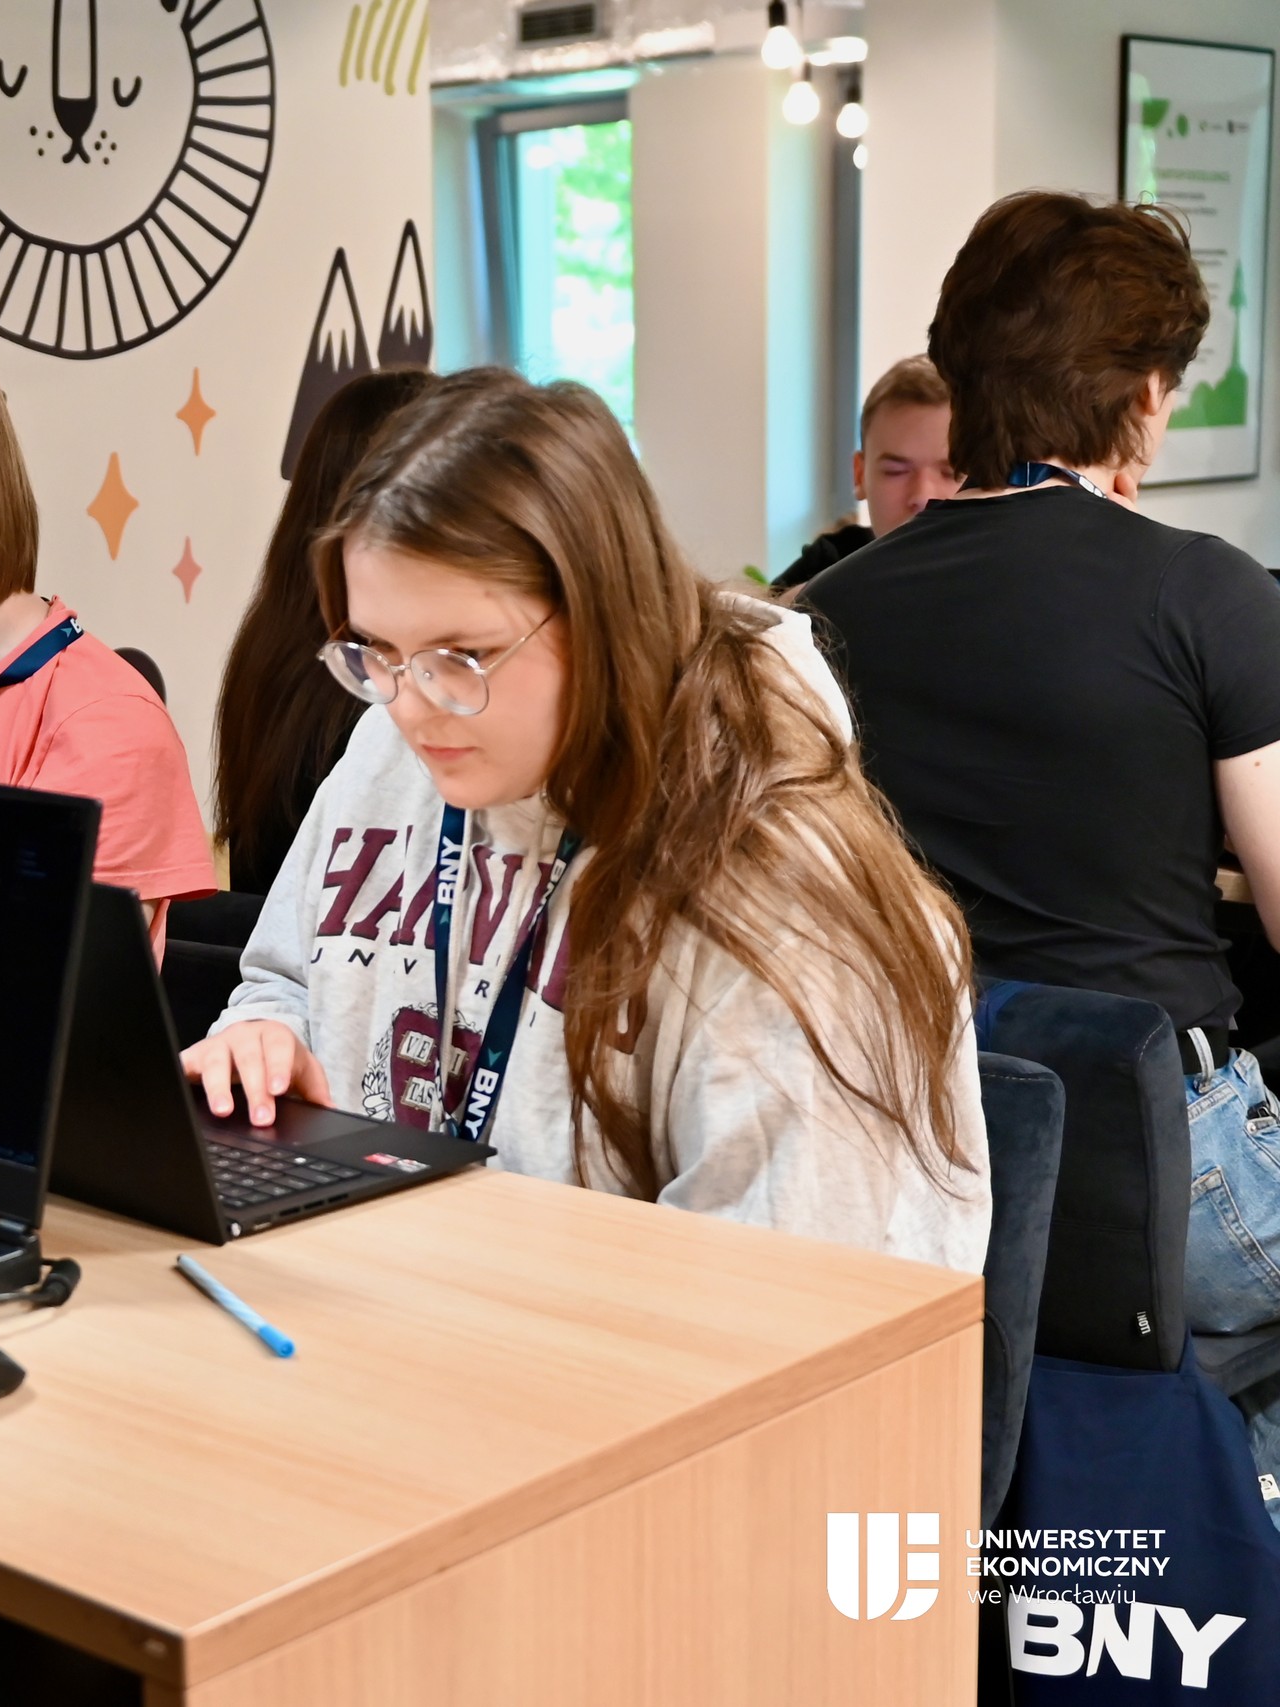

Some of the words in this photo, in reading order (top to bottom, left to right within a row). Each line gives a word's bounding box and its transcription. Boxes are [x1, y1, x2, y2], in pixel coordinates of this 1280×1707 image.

[437, 835, 463, 905] BNY
[406, 1035, 431, 1059] VE
[465, 1067, 499, 1139] BNY
[1007, 1592, 1247, 1689] BNY
